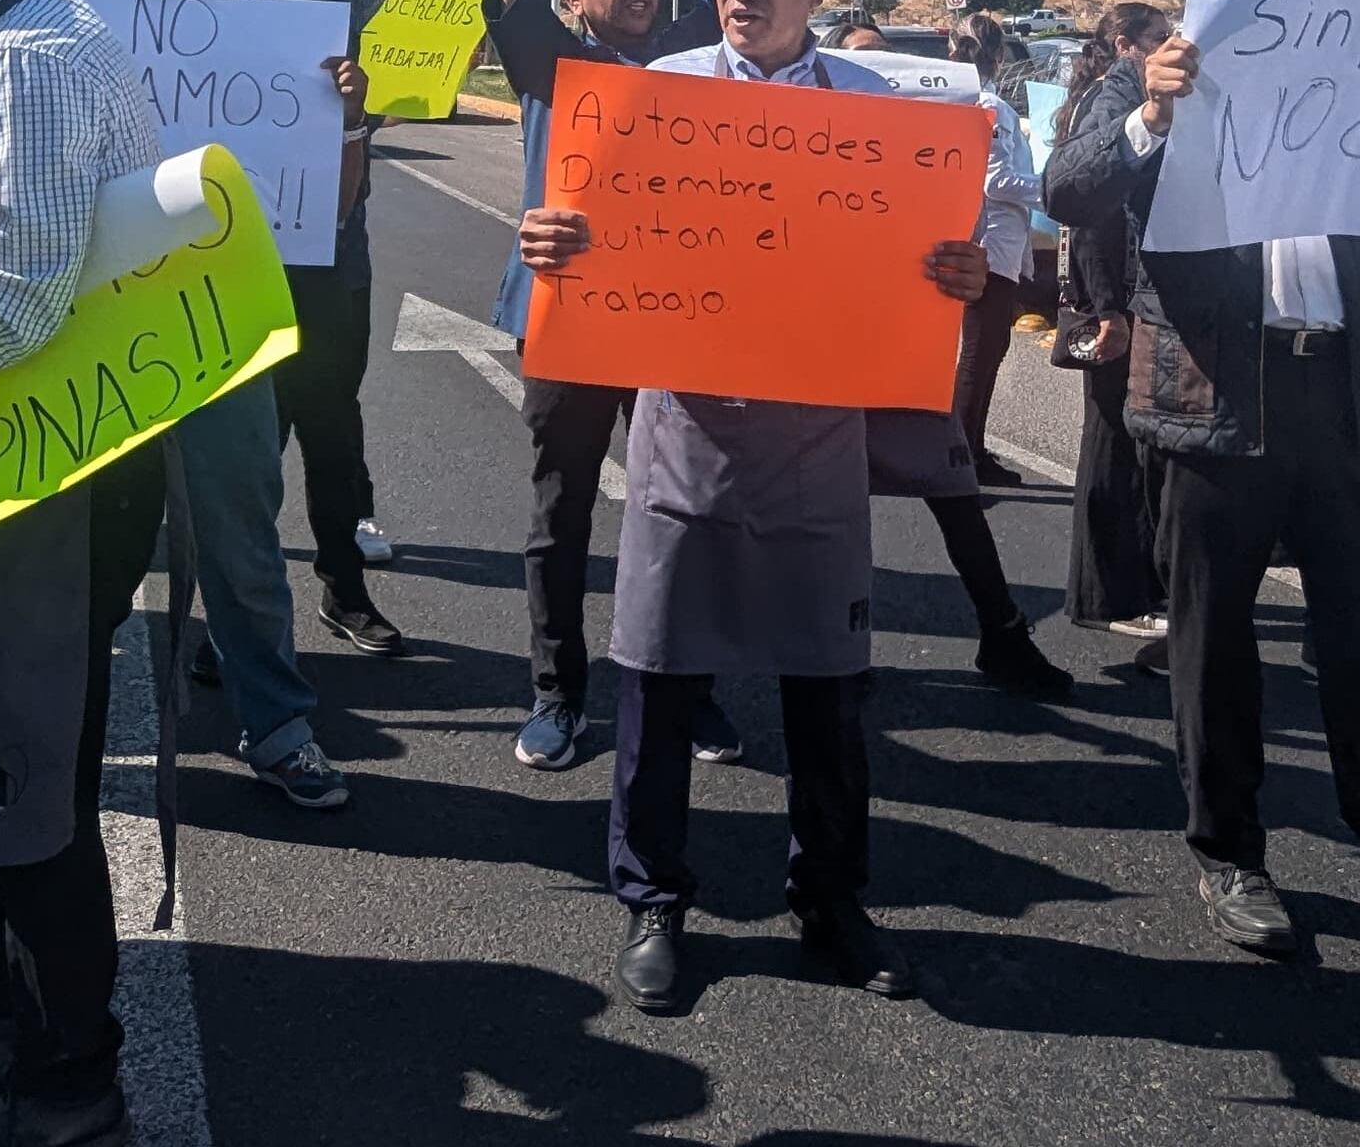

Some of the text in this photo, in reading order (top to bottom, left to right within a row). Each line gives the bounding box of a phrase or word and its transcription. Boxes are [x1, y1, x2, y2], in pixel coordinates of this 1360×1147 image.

[919, 74, 949, 89] en
[572, 90, 963, 170] Autoridades en
[1215, 77, 1337, 186] NO
[559, 153, 891, 215] Diciembre nos
[587, 210, 790, 252] uitan el
